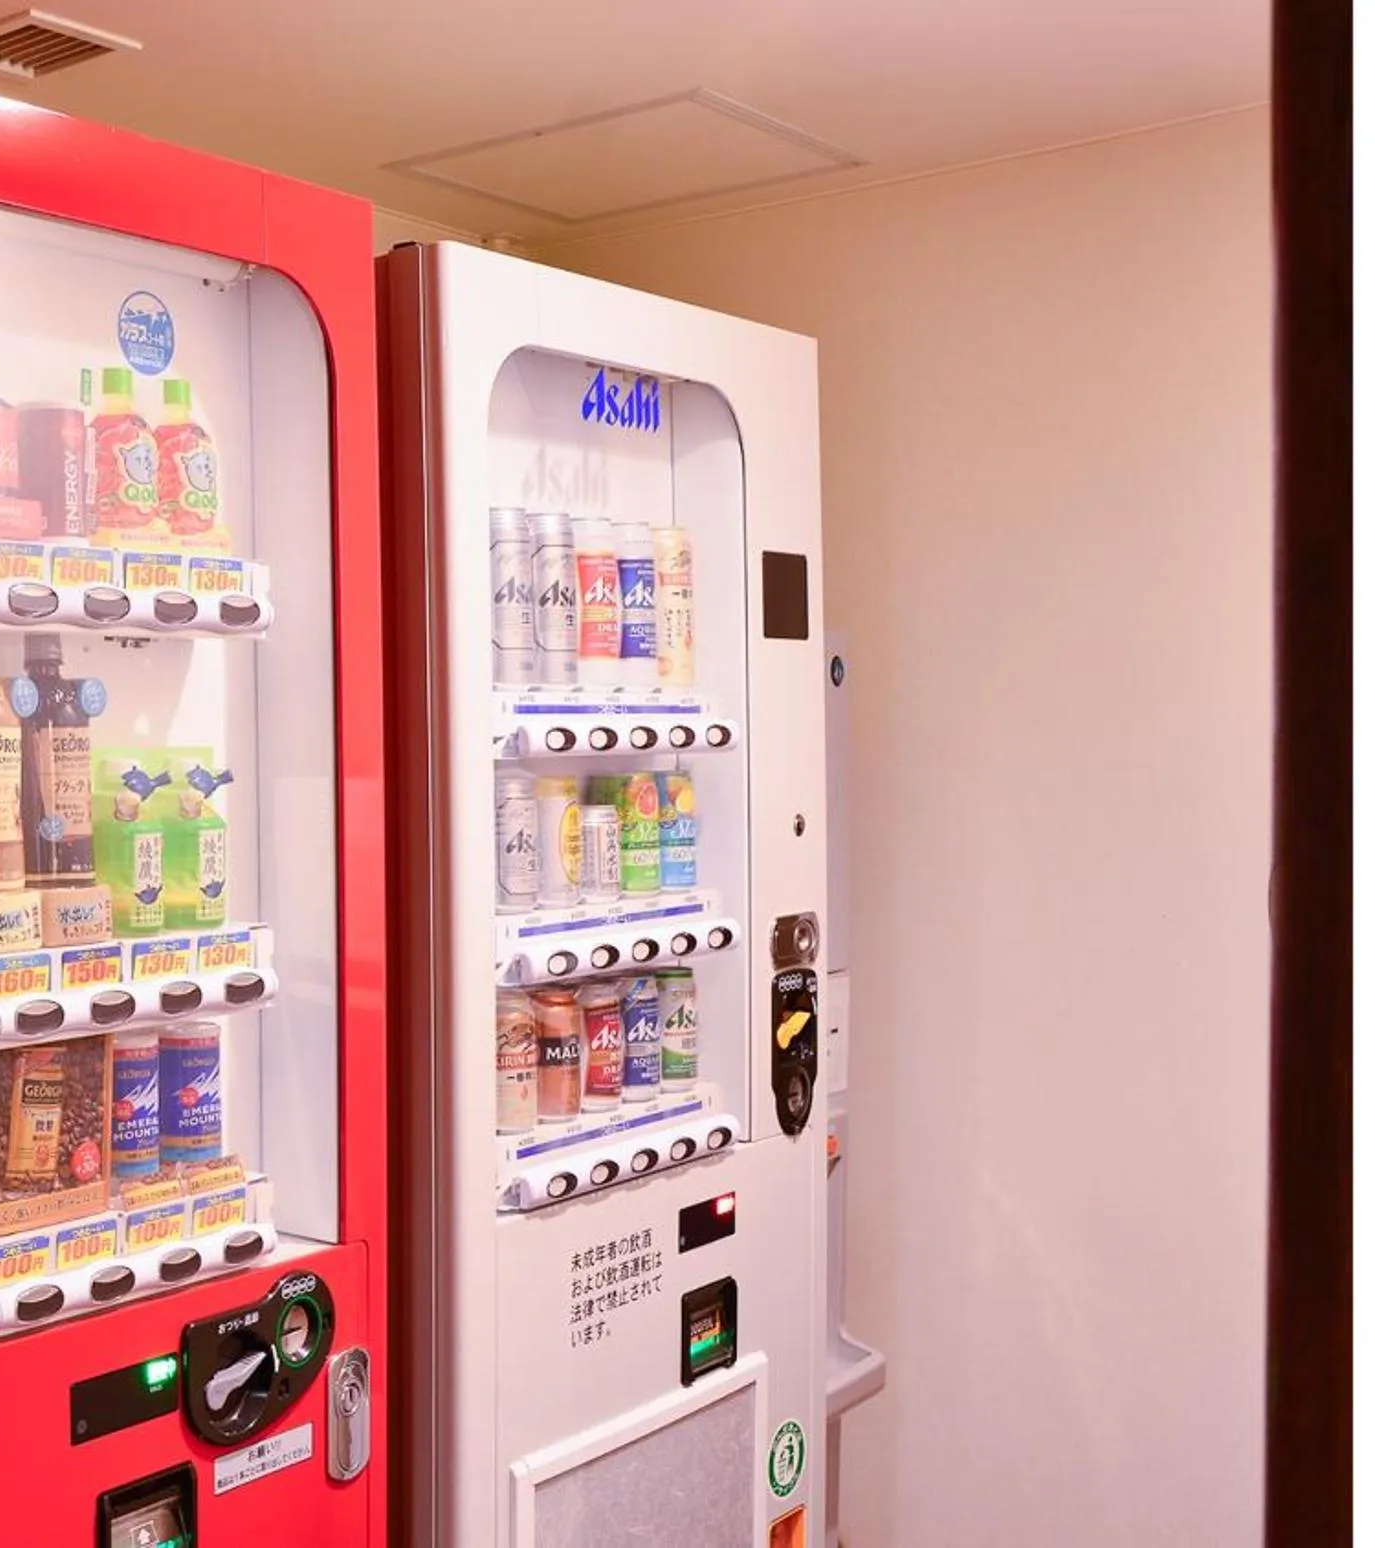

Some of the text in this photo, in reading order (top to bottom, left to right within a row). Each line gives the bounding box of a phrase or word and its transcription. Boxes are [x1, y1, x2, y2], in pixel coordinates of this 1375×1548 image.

[581, 367, 660, 433] Asahi
[63, 451, 80, 534] ENERGY
[138, 952, 185, 976] 130円
[202, 944, 247, 968] 130円
[66, 958, 118, 985] 150円
[198, 1201, 242, 1229] 100円
[133, 1217, 181, 1245] 100円
[62, 1234, 112, 1262] 100円
[570, 1227, 653, 1272] 未成年者の飲酒
[571, 1250, 664, 1298] および飲酒運転は
[568, 1274, 664, 1326] 法律で禁止されて
[570, 1320, 612, 1349] います。
